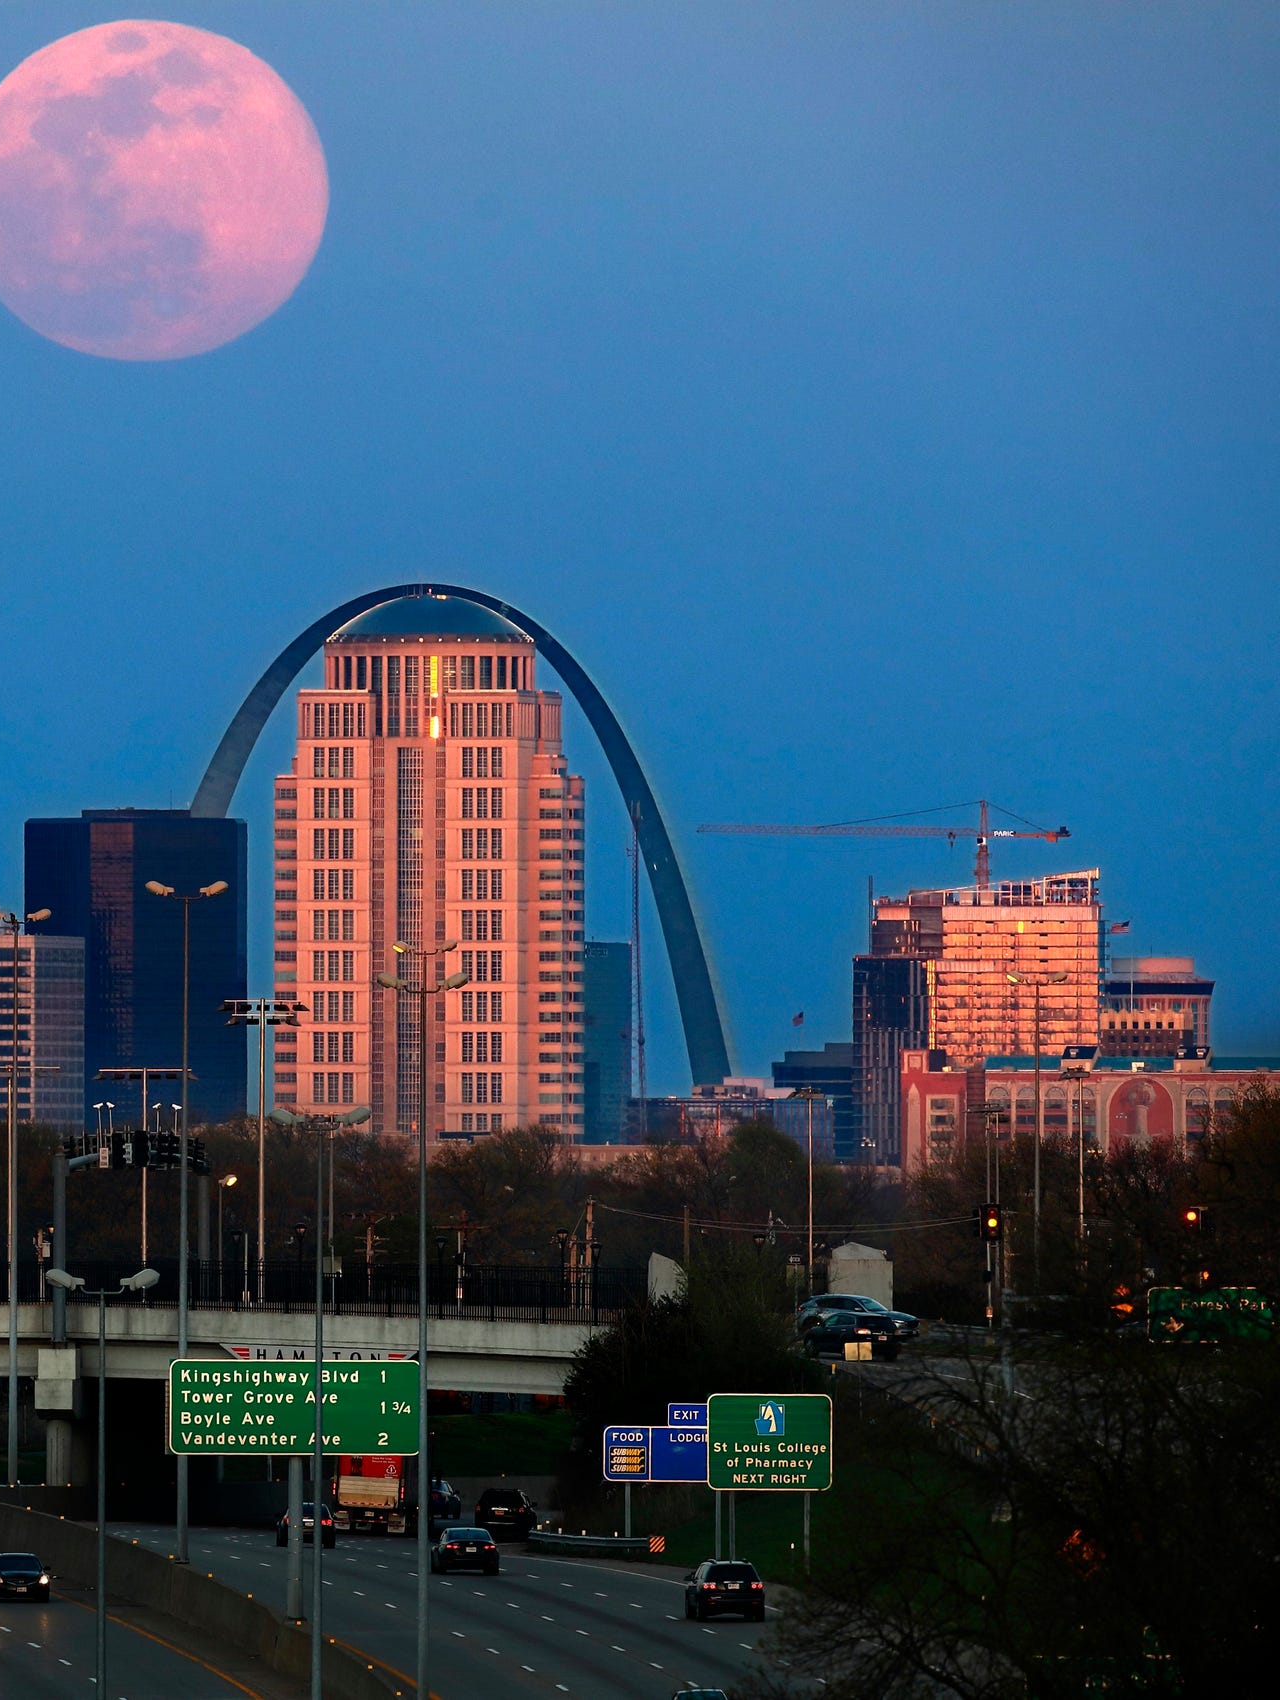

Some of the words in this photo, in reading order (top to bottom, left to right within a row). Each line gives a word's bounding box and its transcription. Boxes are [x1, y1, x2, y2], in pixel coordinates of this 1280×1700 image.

[256, 1348, 381, 1360] HAMTON
[180, 1369, 309, 1386] Kingshighway
[321, 1370, 359, 1383] Blvd
[381, 1370, 386, 1383] 1
[181, 1390, 233, 1403] Tower
[243, 1390, 295, 1404] Grove
[180, 1411, 231, 1428] Boyle
[241, 1411, 275, 1425] Ave
[673, 1410, 700, 1420] EXIT
[181, 1432, 297, 1446] Vandeventer
[377, 1432, 389, 1446] 2
[612, 1432, 644, 1442] FOOD
[669, 1433, 708, 1443] LODGI
[611, 1448, 644, 1456] SUBWAY
[713, 1442, 728, 1453] St
[734, 1442, 771, 1453] Louis
[777, 1442, 827, 1456] College
[611, 1456, 644, 1464] SUBWAY
[726, 1457, 739, 1468] of
[745, 1457, 813, 1470] Pharmacy
[611, 1464, 644, 1472] SUBWAY
[733, 1474, 765, 1484] NEXT
[770, 1474, 807, 1484] RIGHT
